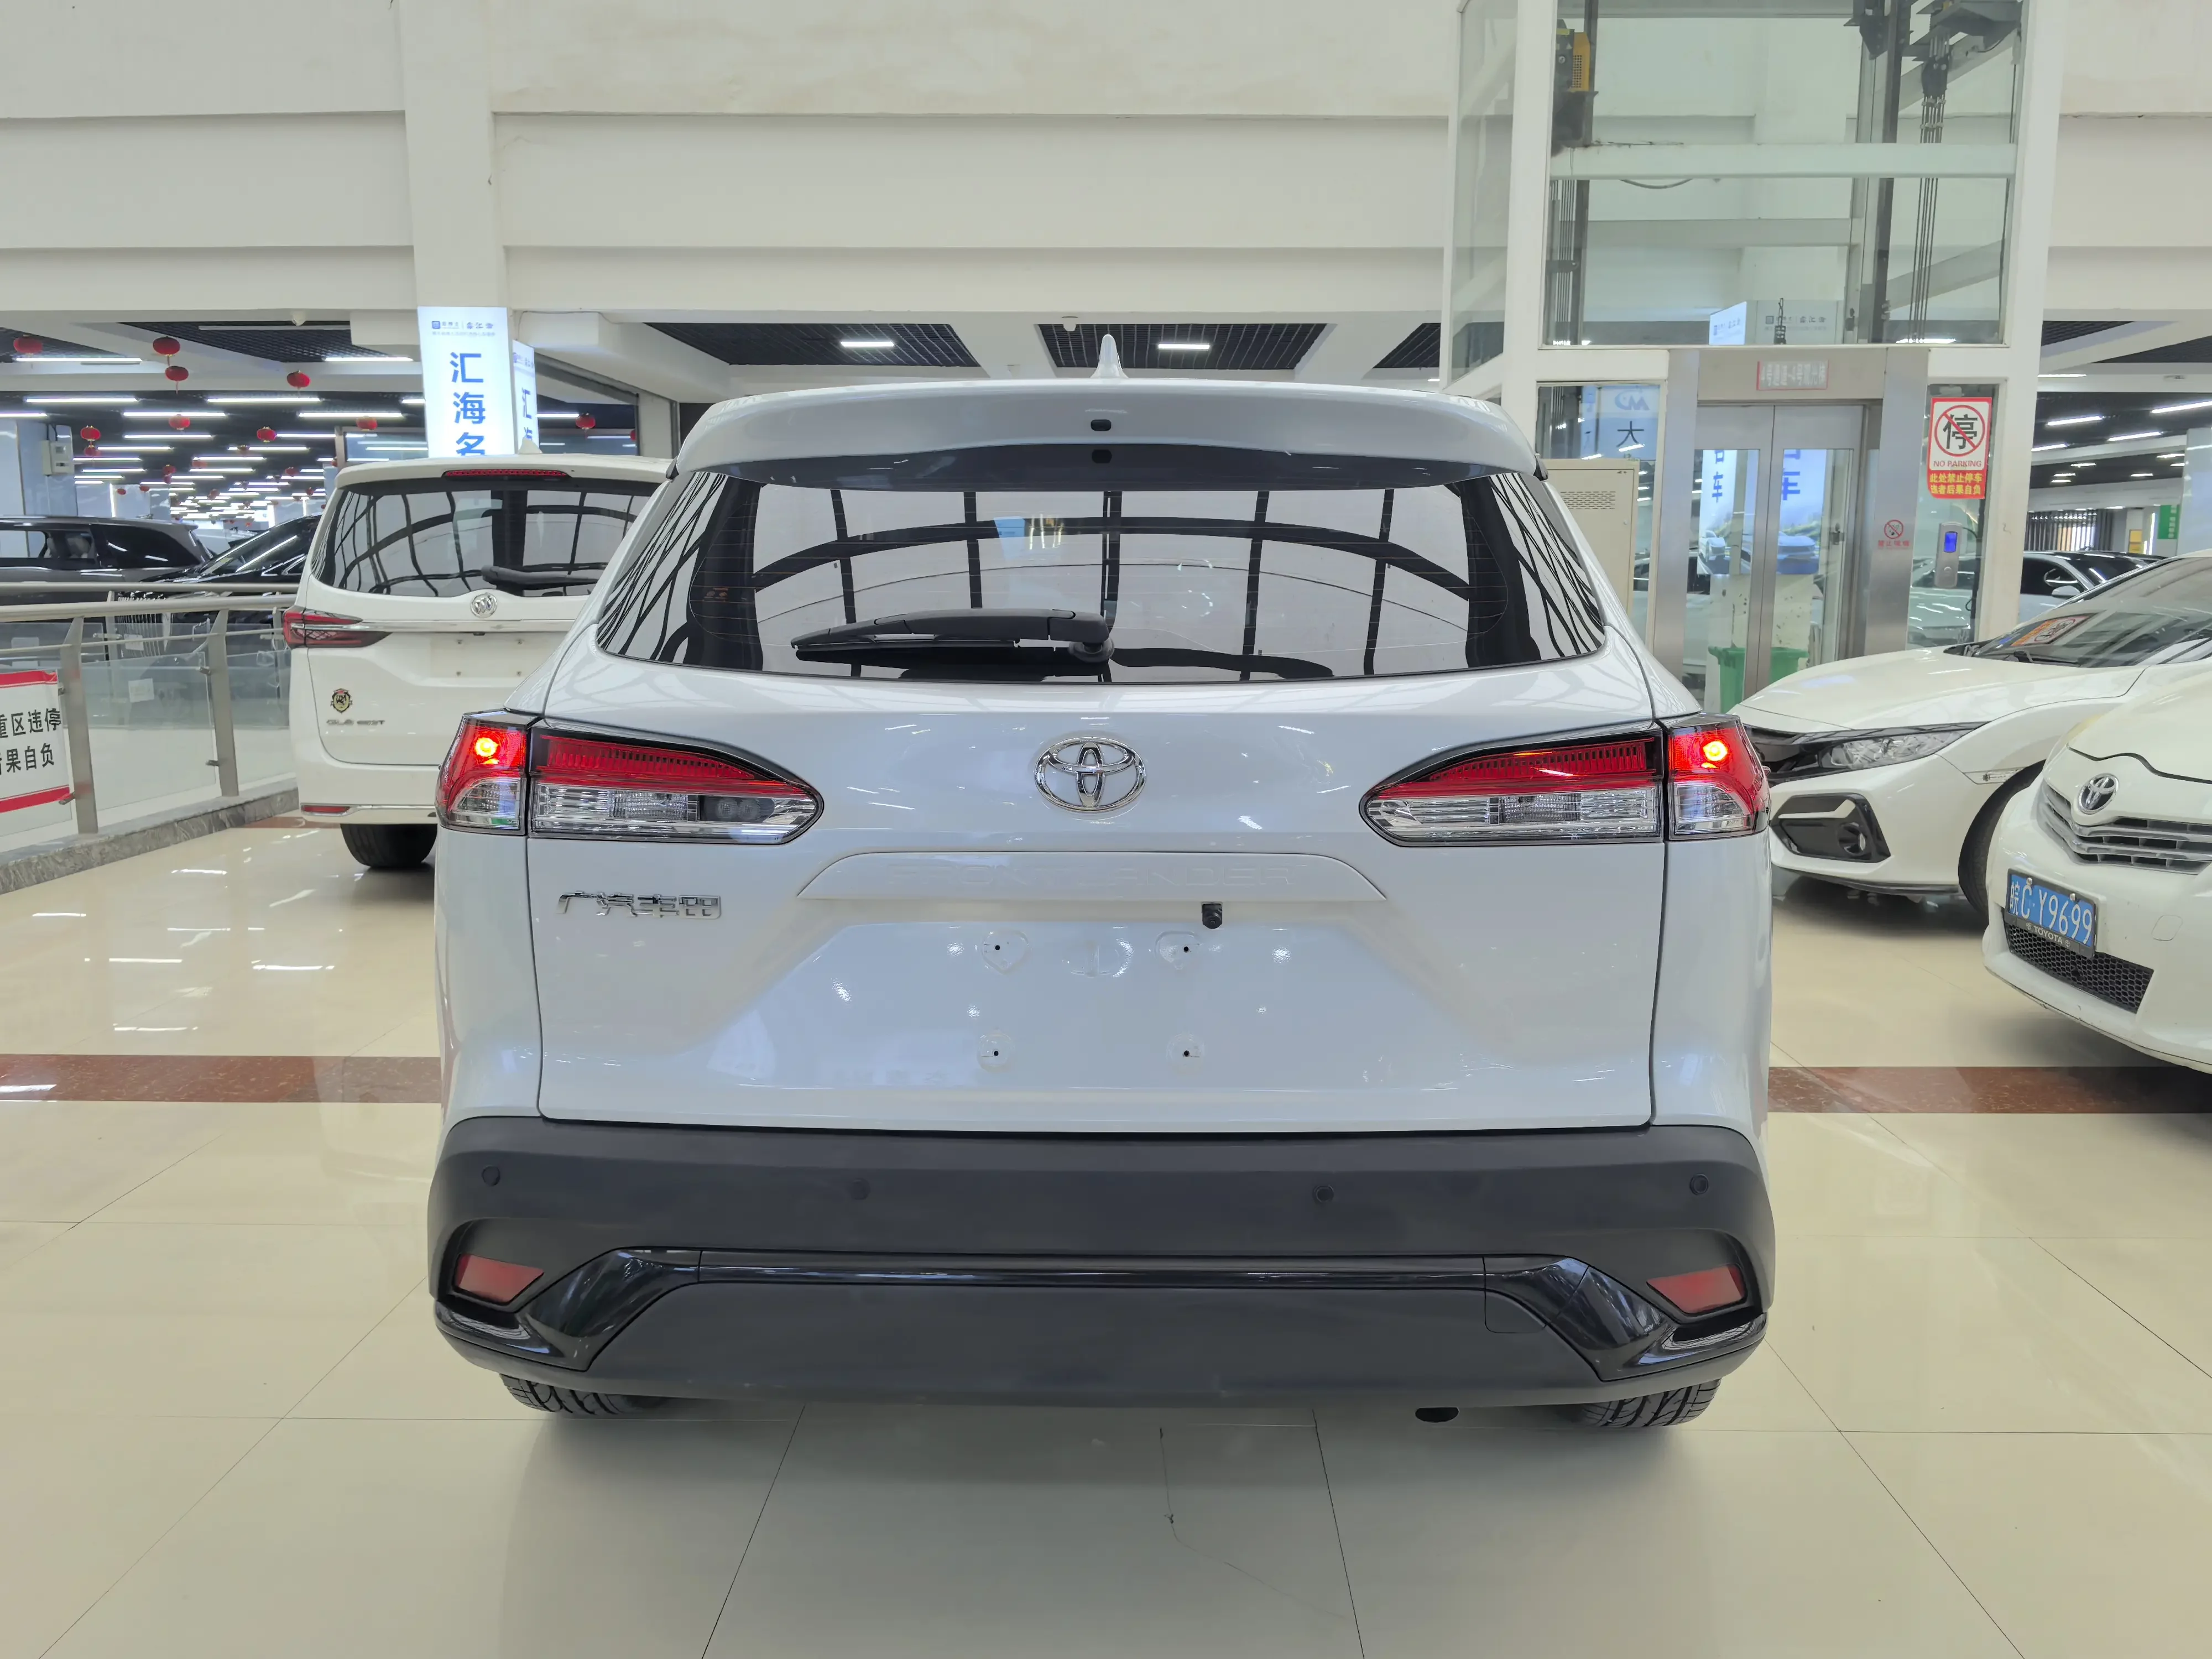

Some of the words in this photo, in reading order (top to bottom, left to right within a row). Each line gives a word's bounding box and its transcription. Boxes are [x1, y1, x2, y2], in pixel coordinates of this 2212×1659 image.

[1942, 414, 1978, 450] 停
[1929, 473, 1983, 483] 此处禁止停车
[0, 743, 54, 778] 果自负
[555, 890, 721, 920] 广汽丰田
[2033, 926, 2063, 944] TOYOTA
